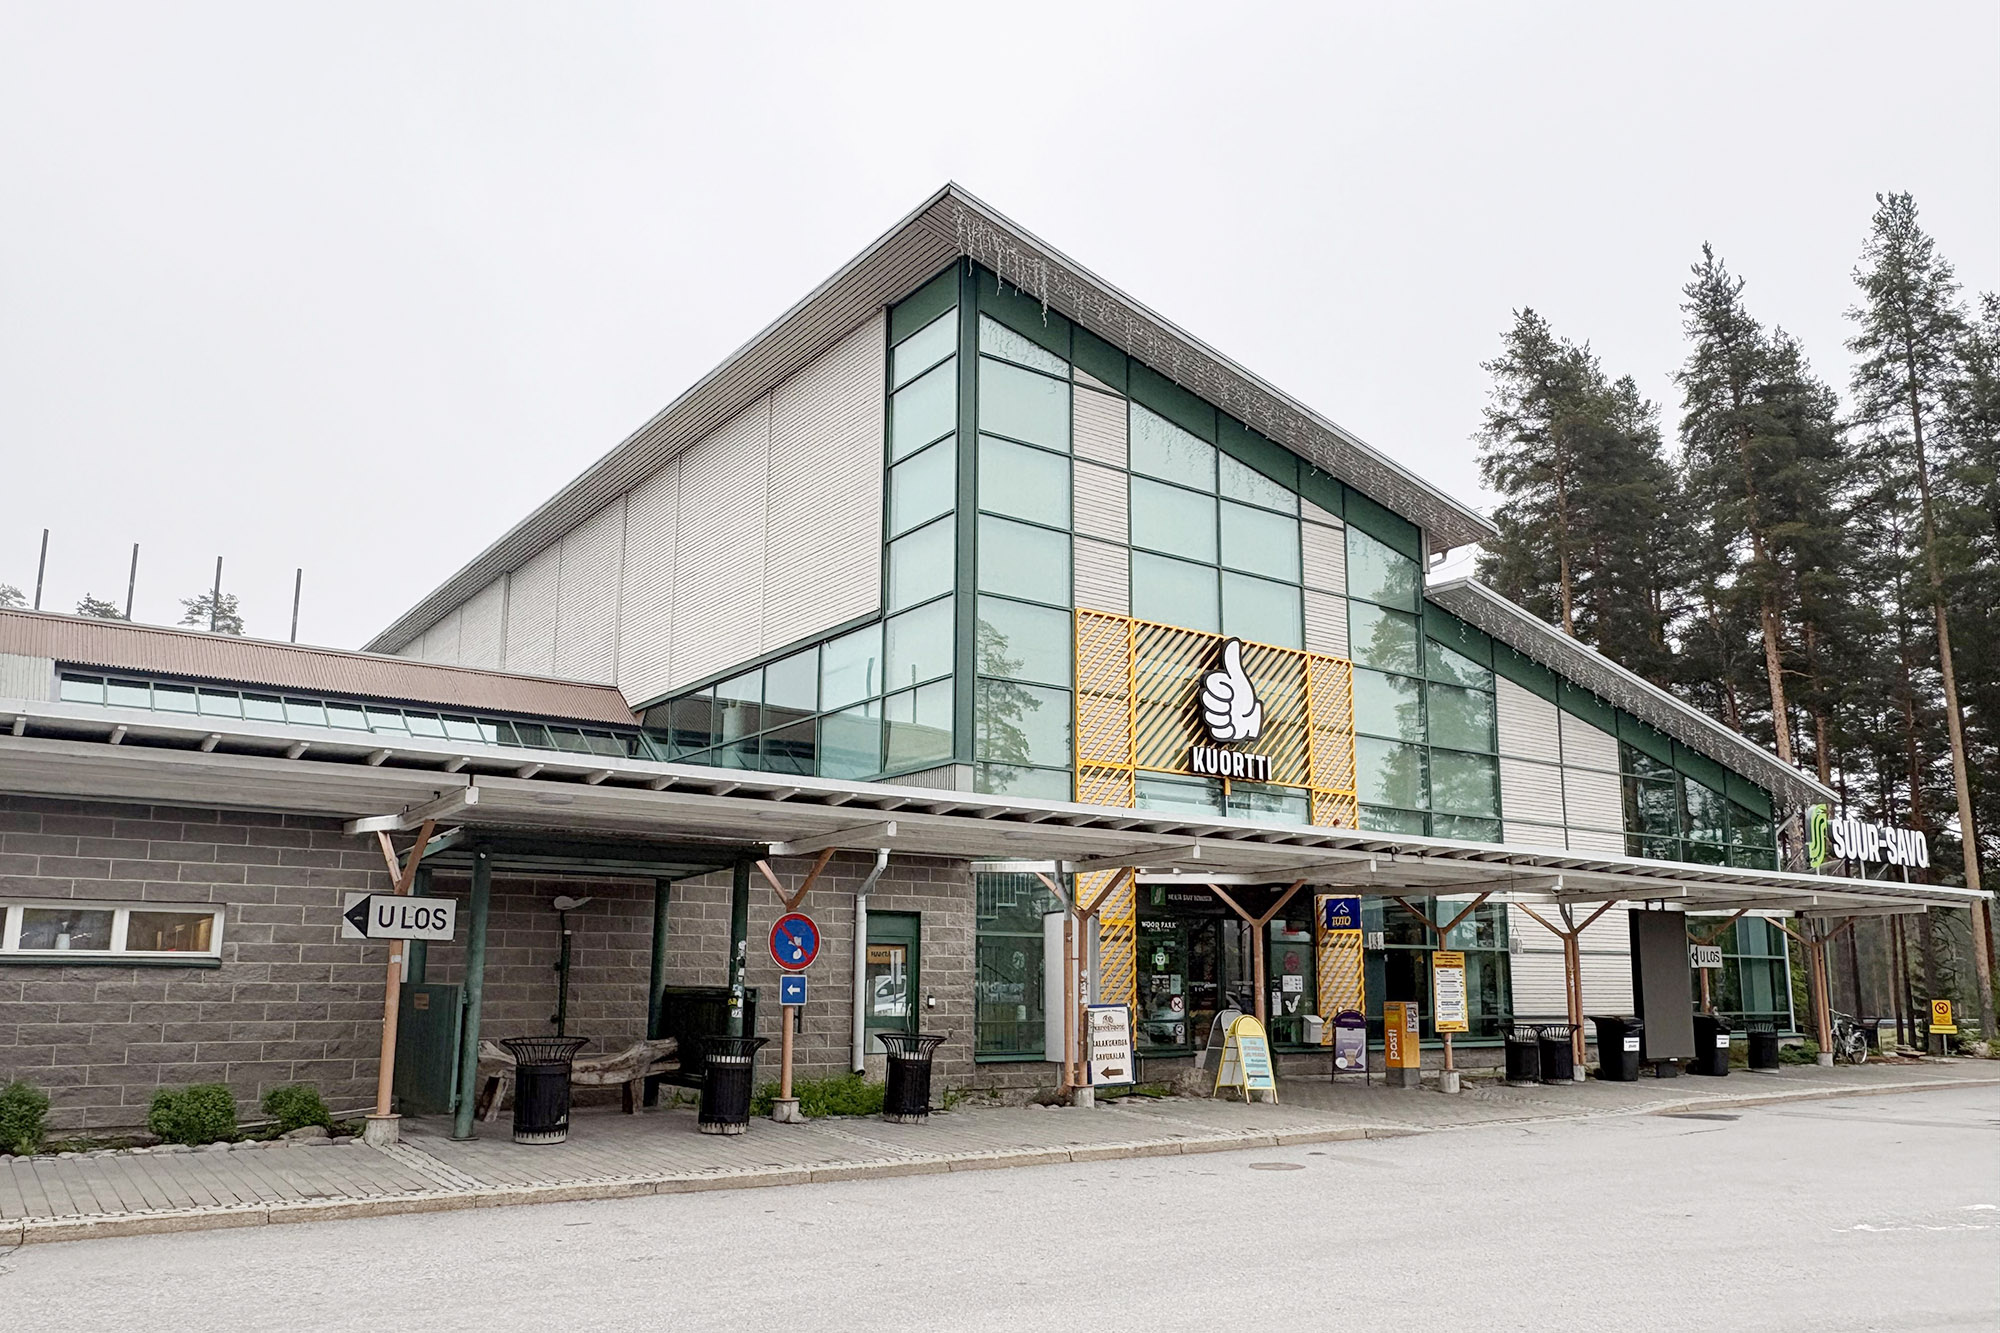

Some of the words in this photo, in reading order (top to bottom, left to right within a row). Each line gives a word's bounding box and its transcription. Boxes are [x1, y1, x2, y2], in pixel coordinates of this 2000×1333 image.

[1193, 746, 1272, 781] KUORTTI
[1832, 819, 1928, 869] SUUR-SAVO
[378, 905, 448, 931] ULOS
[1161, 921, 1177, 929] PARK
[1700, 951, 1720, 963] ULOS
[1387, 1029, 1401, 1060] posti
